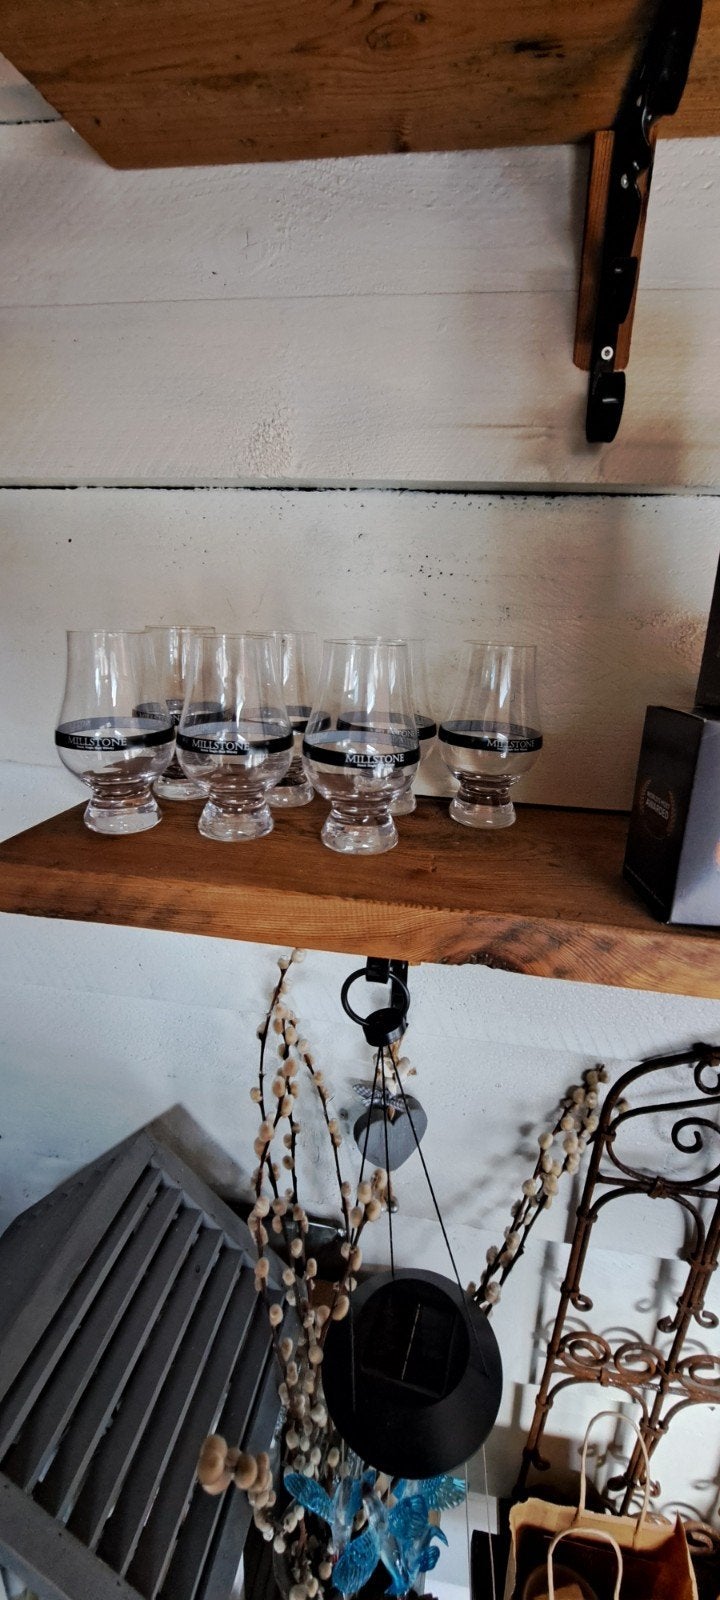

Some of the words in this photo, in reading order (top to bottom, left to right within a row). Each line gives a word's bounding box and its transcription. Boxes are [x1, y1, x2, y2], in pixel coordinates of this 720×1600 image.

[67, 736, 127, 747] MILLSTONE
[191, 739, 250, 751] MILLSTONE
[345, 753, 405, 765] MILLSTONE
